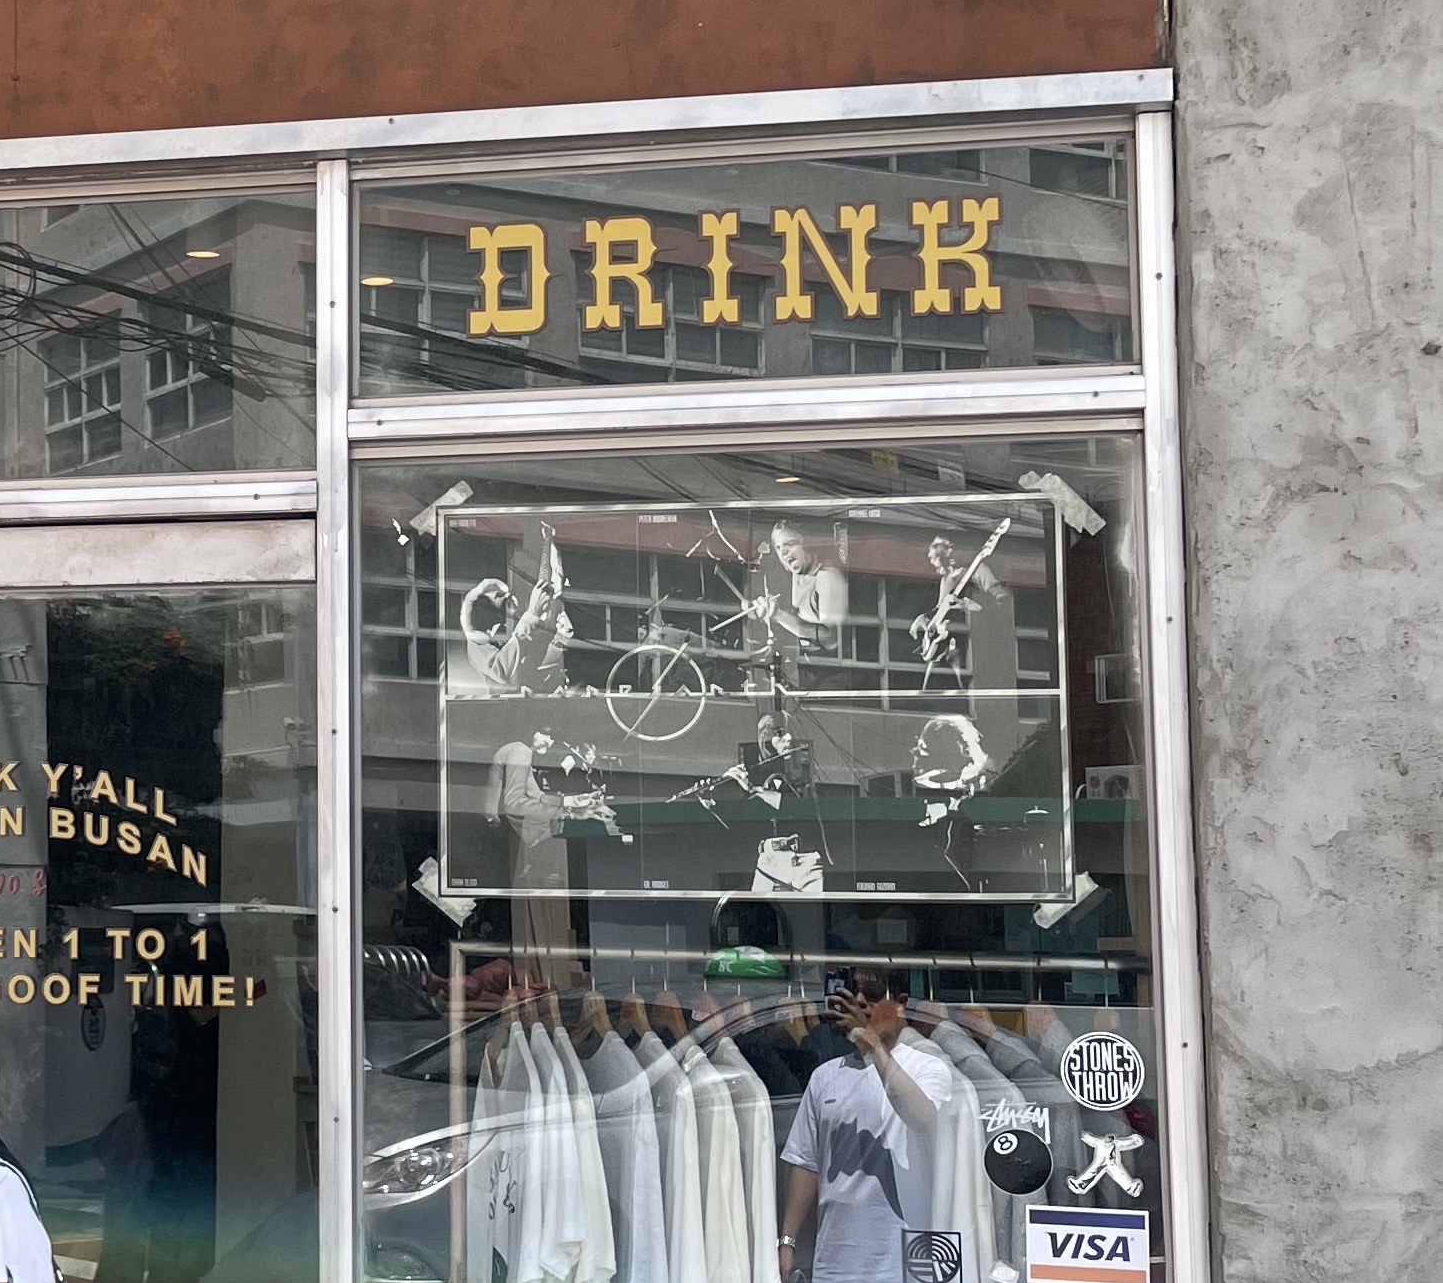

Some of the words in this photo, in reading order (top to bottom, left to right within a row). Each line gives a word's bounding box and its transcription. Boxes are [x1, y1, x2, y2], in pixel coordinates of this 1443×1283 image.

[465, 194, 1003, 337] DRINK
[50, 807, 208, 887] BUSAN
[61, 927, 81, 961] 1
[105, 927, 167, 961] TO
[189, 927, 208, 961] 1
[123, 973, 256, 1008] TIME!
[1068, 1041, 1135, 1072] STONES
[1071, 1069, 1136, 1103] THROW
[997, 1135, 1014, 1151] 8
[1047, 1230, 1132, 1263] VISA
